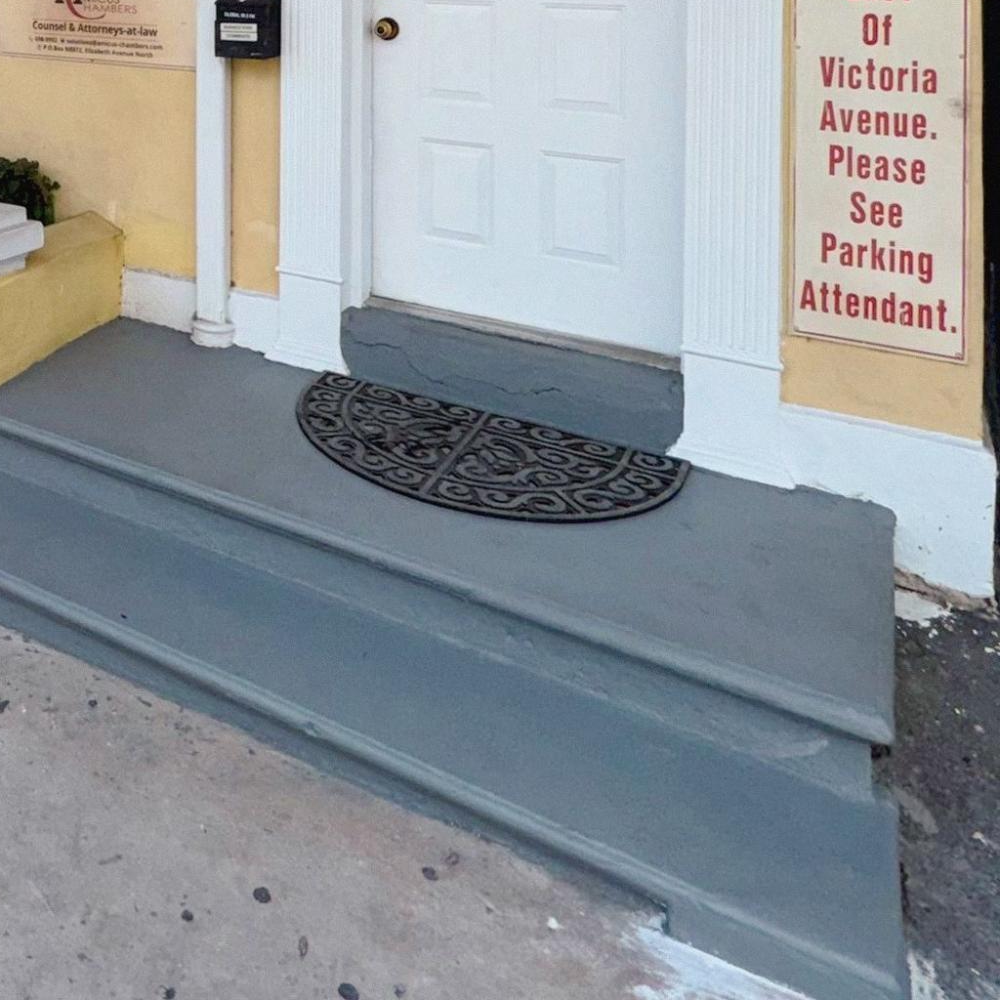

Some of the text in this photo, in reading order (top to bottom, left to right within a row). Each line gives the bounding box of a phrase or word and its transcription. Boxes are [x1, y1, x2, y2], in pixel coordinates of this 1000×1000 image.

[32, 20, 158, 37] Counsel & Attorneys-at-law
[862, 13, 893, 46] Of
[819, 56, 938, 94] Victoria
[820, 99, 937, 140] Avenue.
[828, 144, 926, 185] Please
[850, 191, 903, 229] See
[821, 232, 933, 285] Parking
[800, 279, 957, 334] Attendant.
